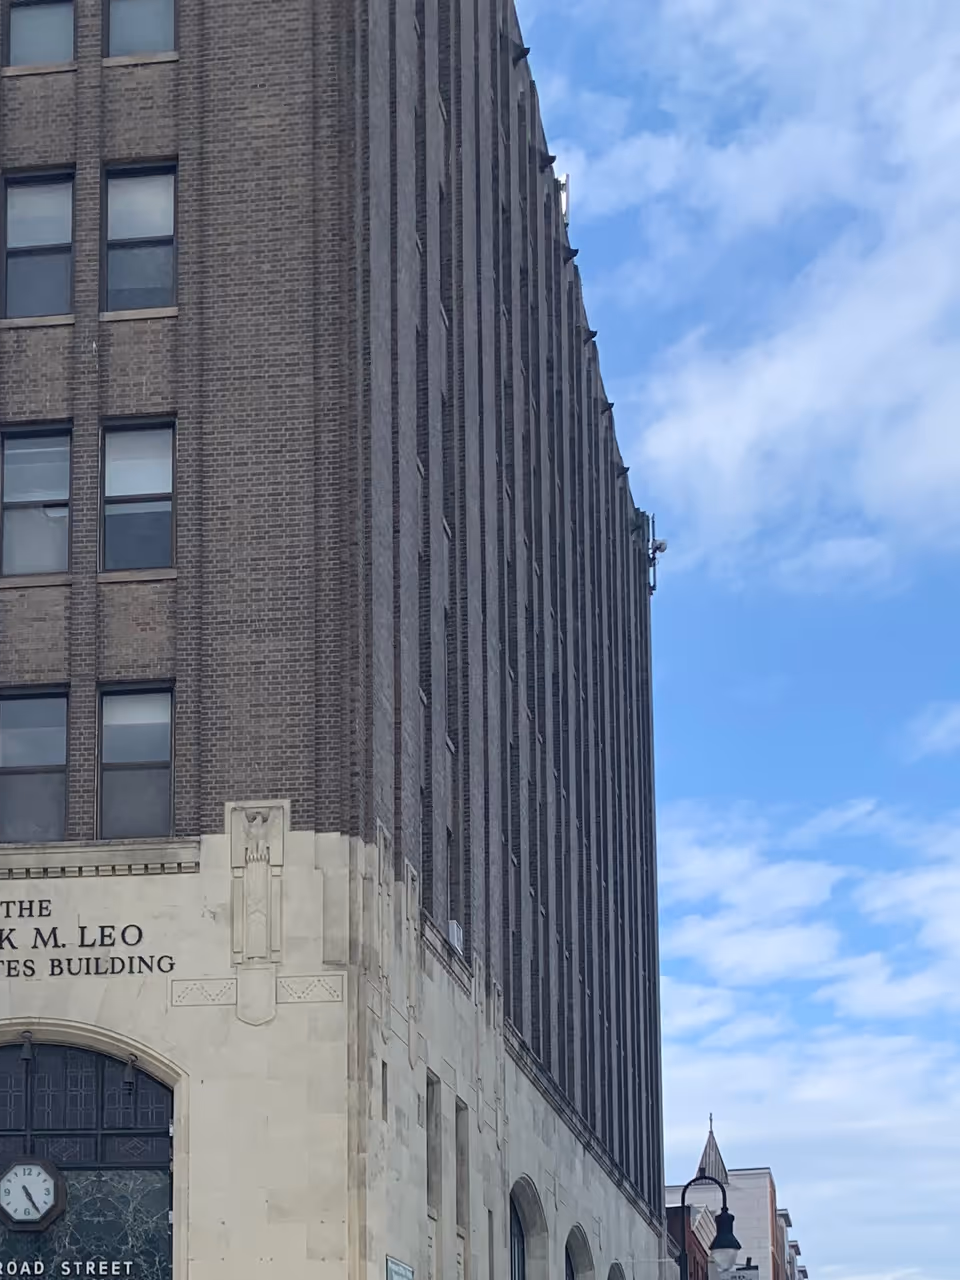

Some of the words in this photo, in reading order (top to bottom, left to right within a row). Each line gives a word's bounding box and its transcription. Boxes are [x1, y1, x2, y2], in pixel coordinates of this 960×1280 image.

[0, 899, 52, 918] THE
[31, 926, 66, 949] M.
[78, 924, 143, 948] LEO
[48, 955, 176, 976] BUILDING
[22, 1168, 33, 1176] 12
[4, 1188, 11, 1197] 9
[44, 1188, 51, 1196] 3
[23, 1208, 31, 1216] 6
[61, 1261, 133, 1275] STREET
